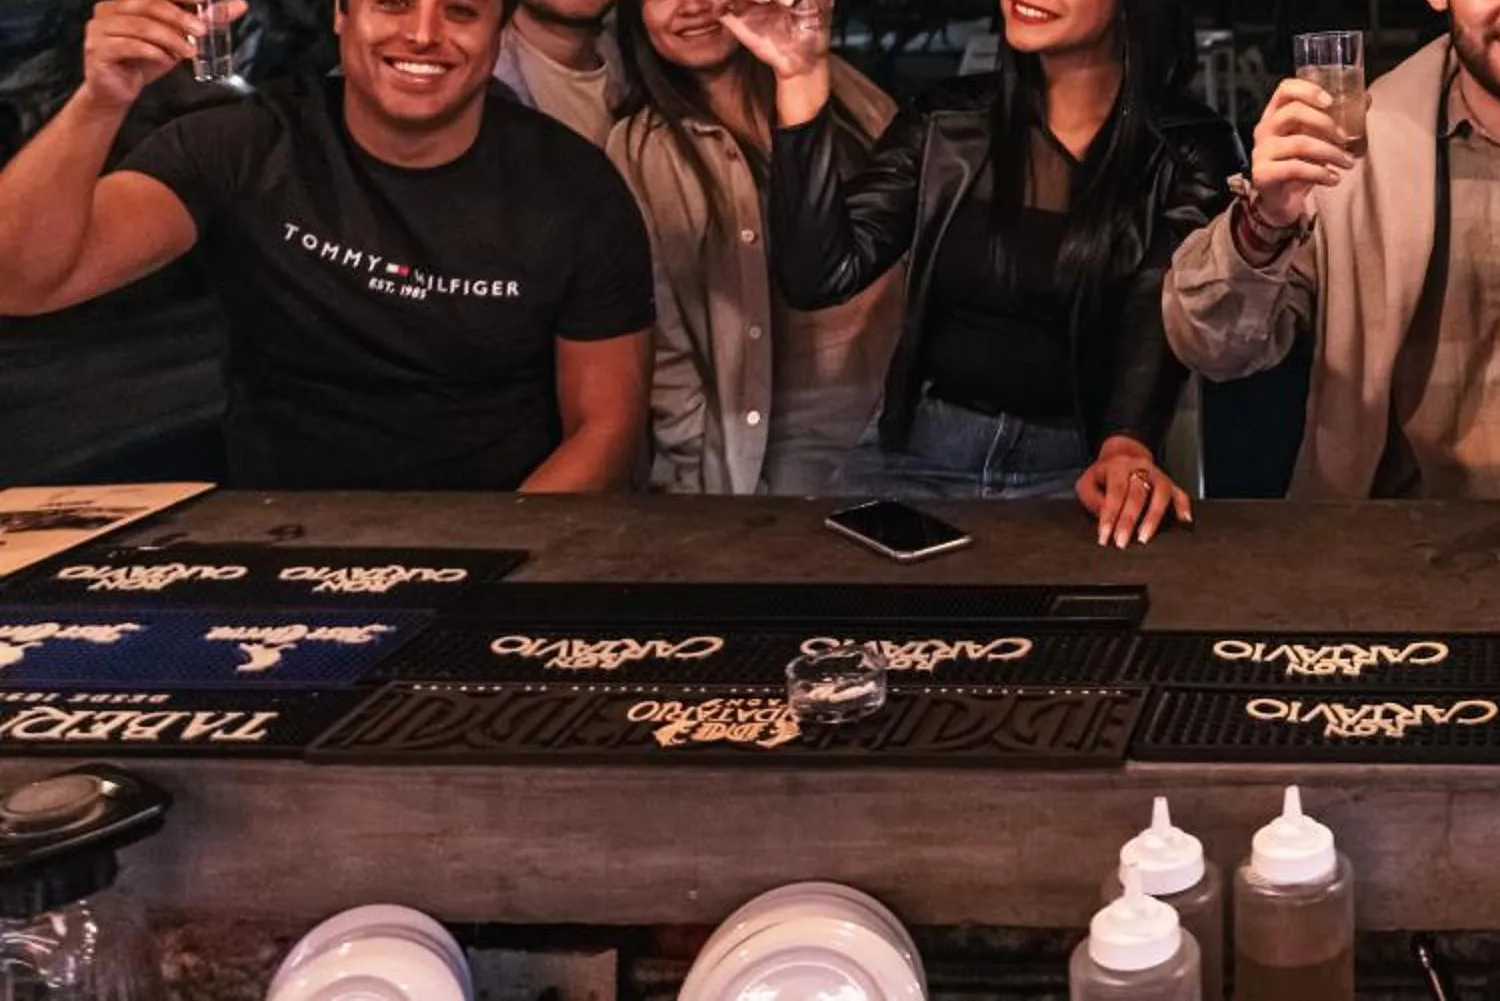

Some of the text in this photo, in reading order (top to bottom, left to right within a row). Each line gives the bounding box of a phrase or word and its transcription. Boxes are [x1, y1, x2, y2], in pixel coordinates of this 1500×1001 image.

[284, 223, 383, 272] TOMMY
[490, 635, 725, 660] CARTAVIO
[1213, 640, 1449, 664] CARTAVIO
[544, 654, 628, 670] RON
[1286, 660, 1361, 676] RON
[0, 706, 279, 741] TABER
[1246, 699, 1498, 726] CARTAVIO
[1324, 721, 1404, 737] RON
